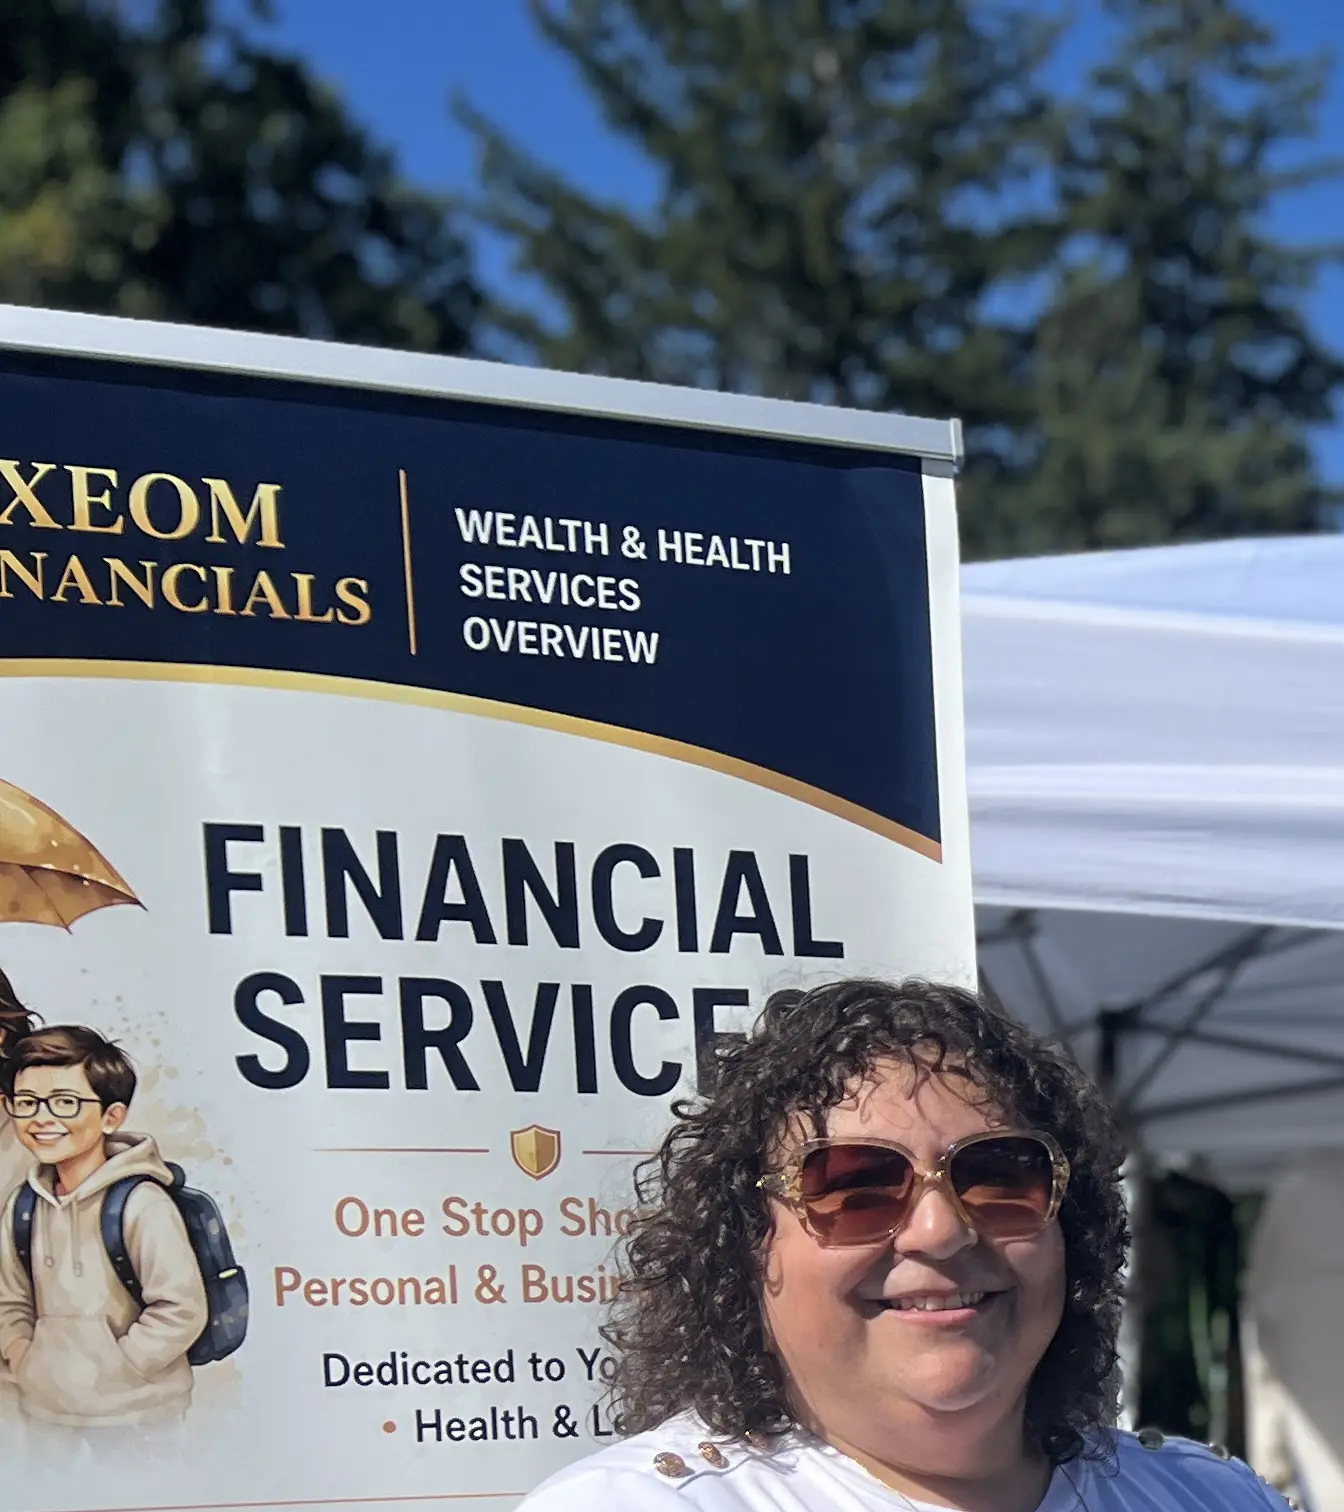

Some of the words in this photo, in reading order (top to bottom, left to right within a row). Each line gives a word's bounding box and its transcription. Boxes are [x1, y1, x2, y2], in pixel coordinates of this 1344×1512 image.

[455, 508, 608, 555] WEALTH
[622, 526, 646, 559] &
[658, 530, 790, 574] HEALTH
[460, 564, 640, 610] SERVICES
[464, 617, 658, 664] OVERVIEW
[204, 823, 844, 958] FINANCIAL
[233, 973, 749, 1095] SERVICE
[275, 1265, 457, 1306] Personal
[476, 1264, 506, 1304] &
